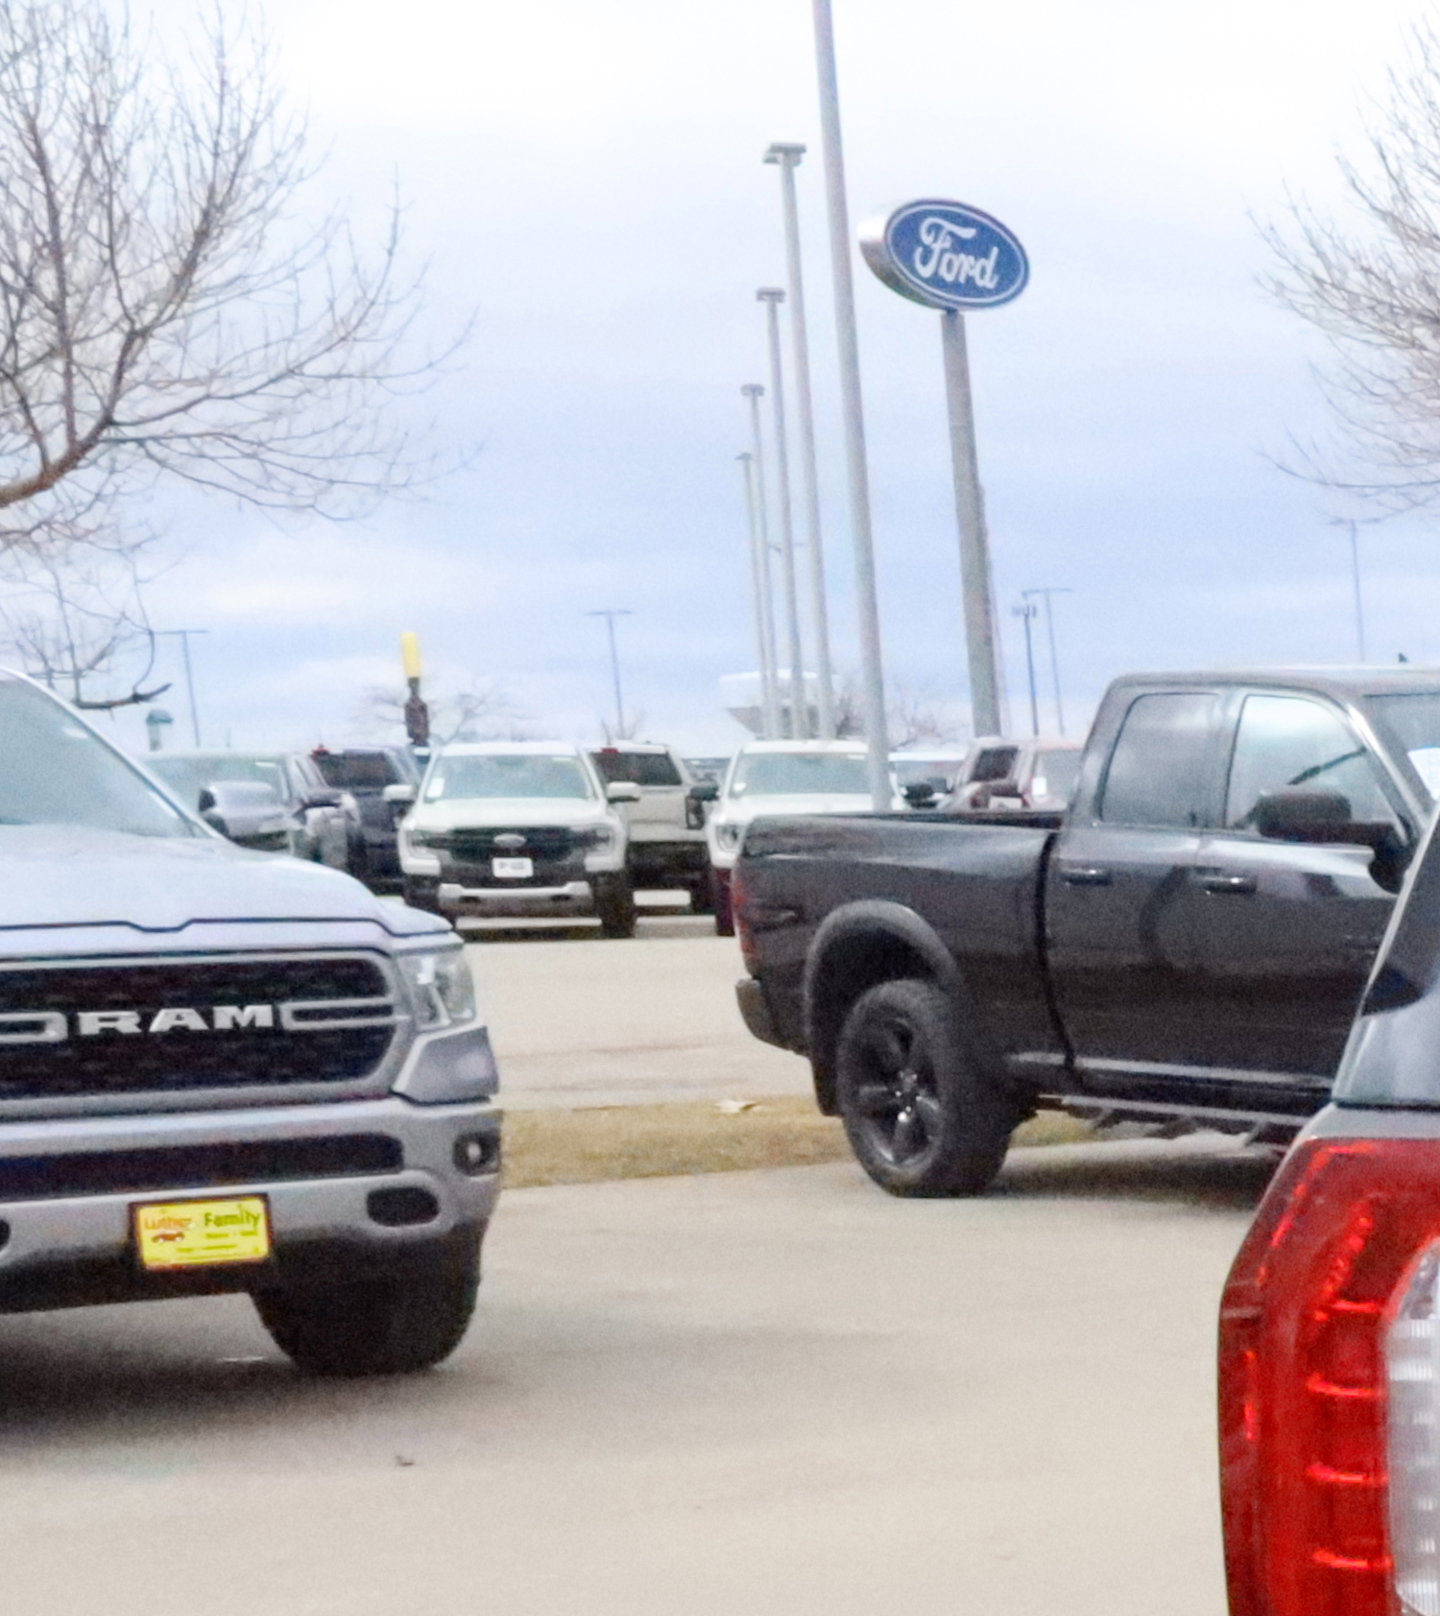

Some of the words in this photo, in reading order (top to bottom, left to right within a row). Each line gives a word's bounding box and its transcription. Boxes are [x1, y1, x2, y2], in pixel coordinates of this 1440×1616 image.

[914, 216, 999, 289] Ford
[78, 1005, 273, 1036] RAM
[204, 1207, 261, 1228] Family
